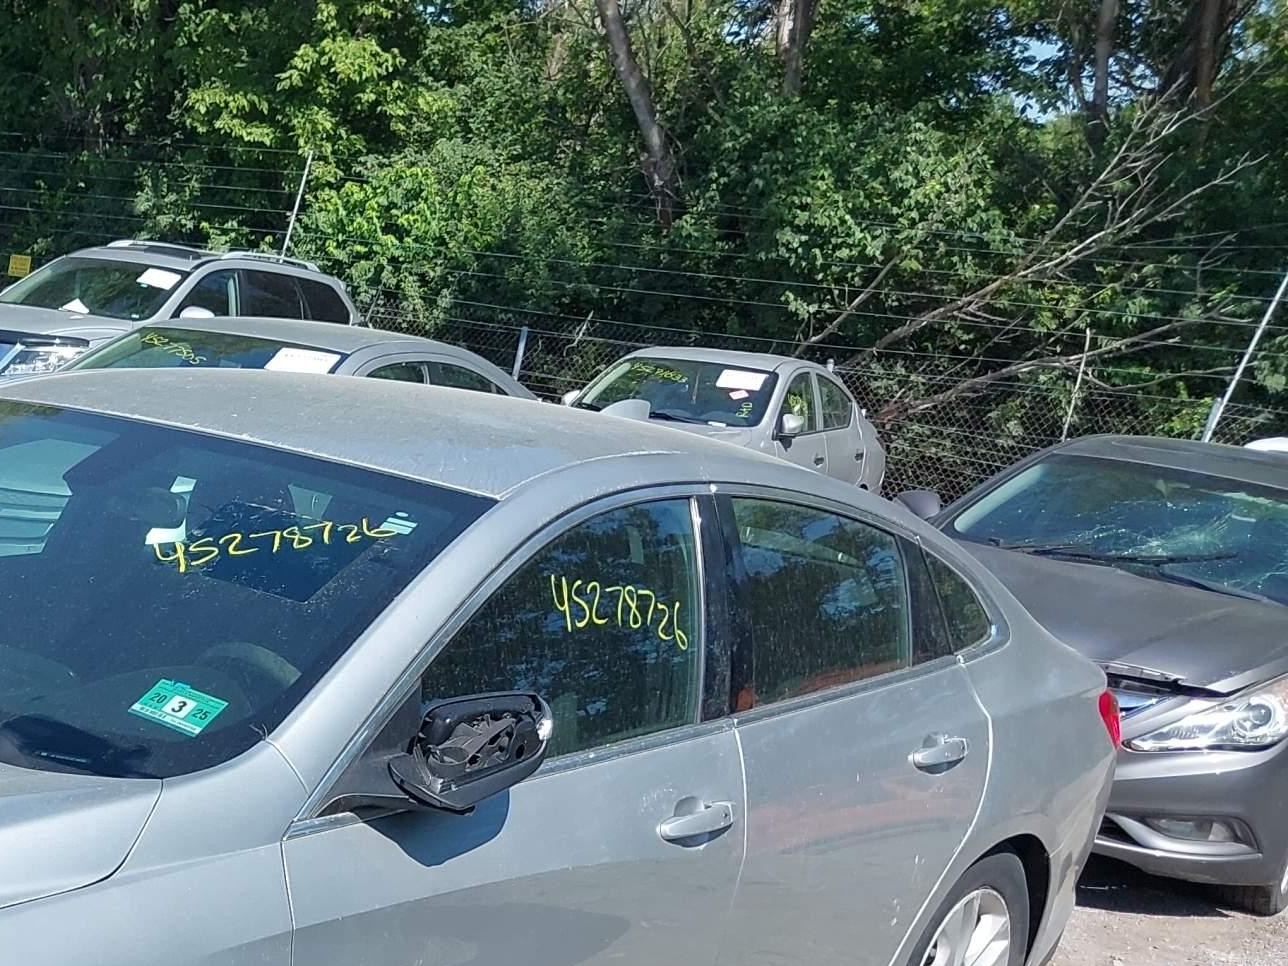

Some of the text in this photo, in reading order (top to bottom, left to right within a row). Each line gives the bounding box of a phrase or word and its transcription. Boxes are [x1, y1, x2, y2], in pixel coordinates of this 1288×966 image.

[152, 516, 398, 574] 45278726
[550, 573, 689, 651] 45278726
[149, 692, 168, 704] 20
[171, 700, 188, 713] 3
[192, 708, 212, 721] 25
